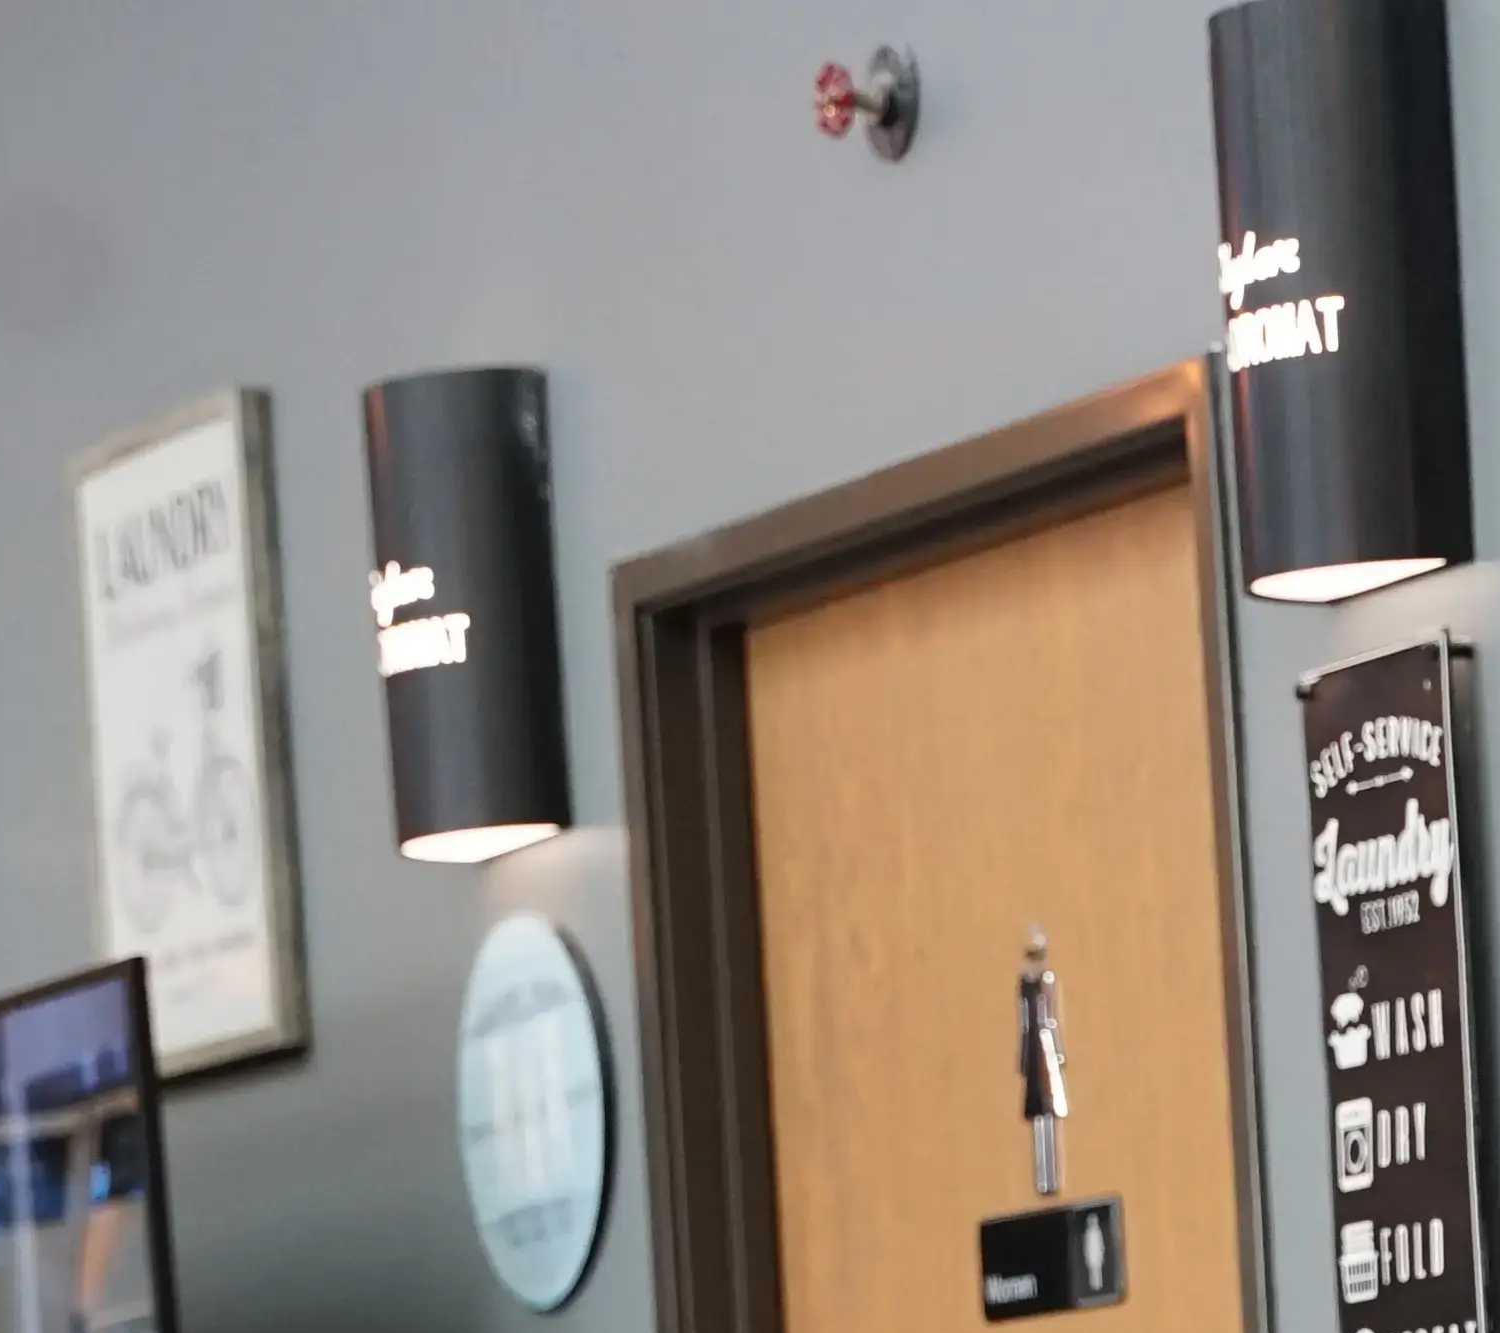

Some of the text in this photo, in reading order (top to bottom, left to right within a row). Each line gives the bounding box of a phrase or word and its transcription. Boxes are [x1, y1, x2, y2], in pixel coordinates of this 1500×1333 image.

[1310, 716, 1442, 798] SELF-SERVICE
[1313, 798, 1454, 916] Laundry
[1371, 988, 1444, 1060] WASH
[1377, 1102, 1426, 1168] DRY
[1380, 1218, 1444, 1285] FOLD
